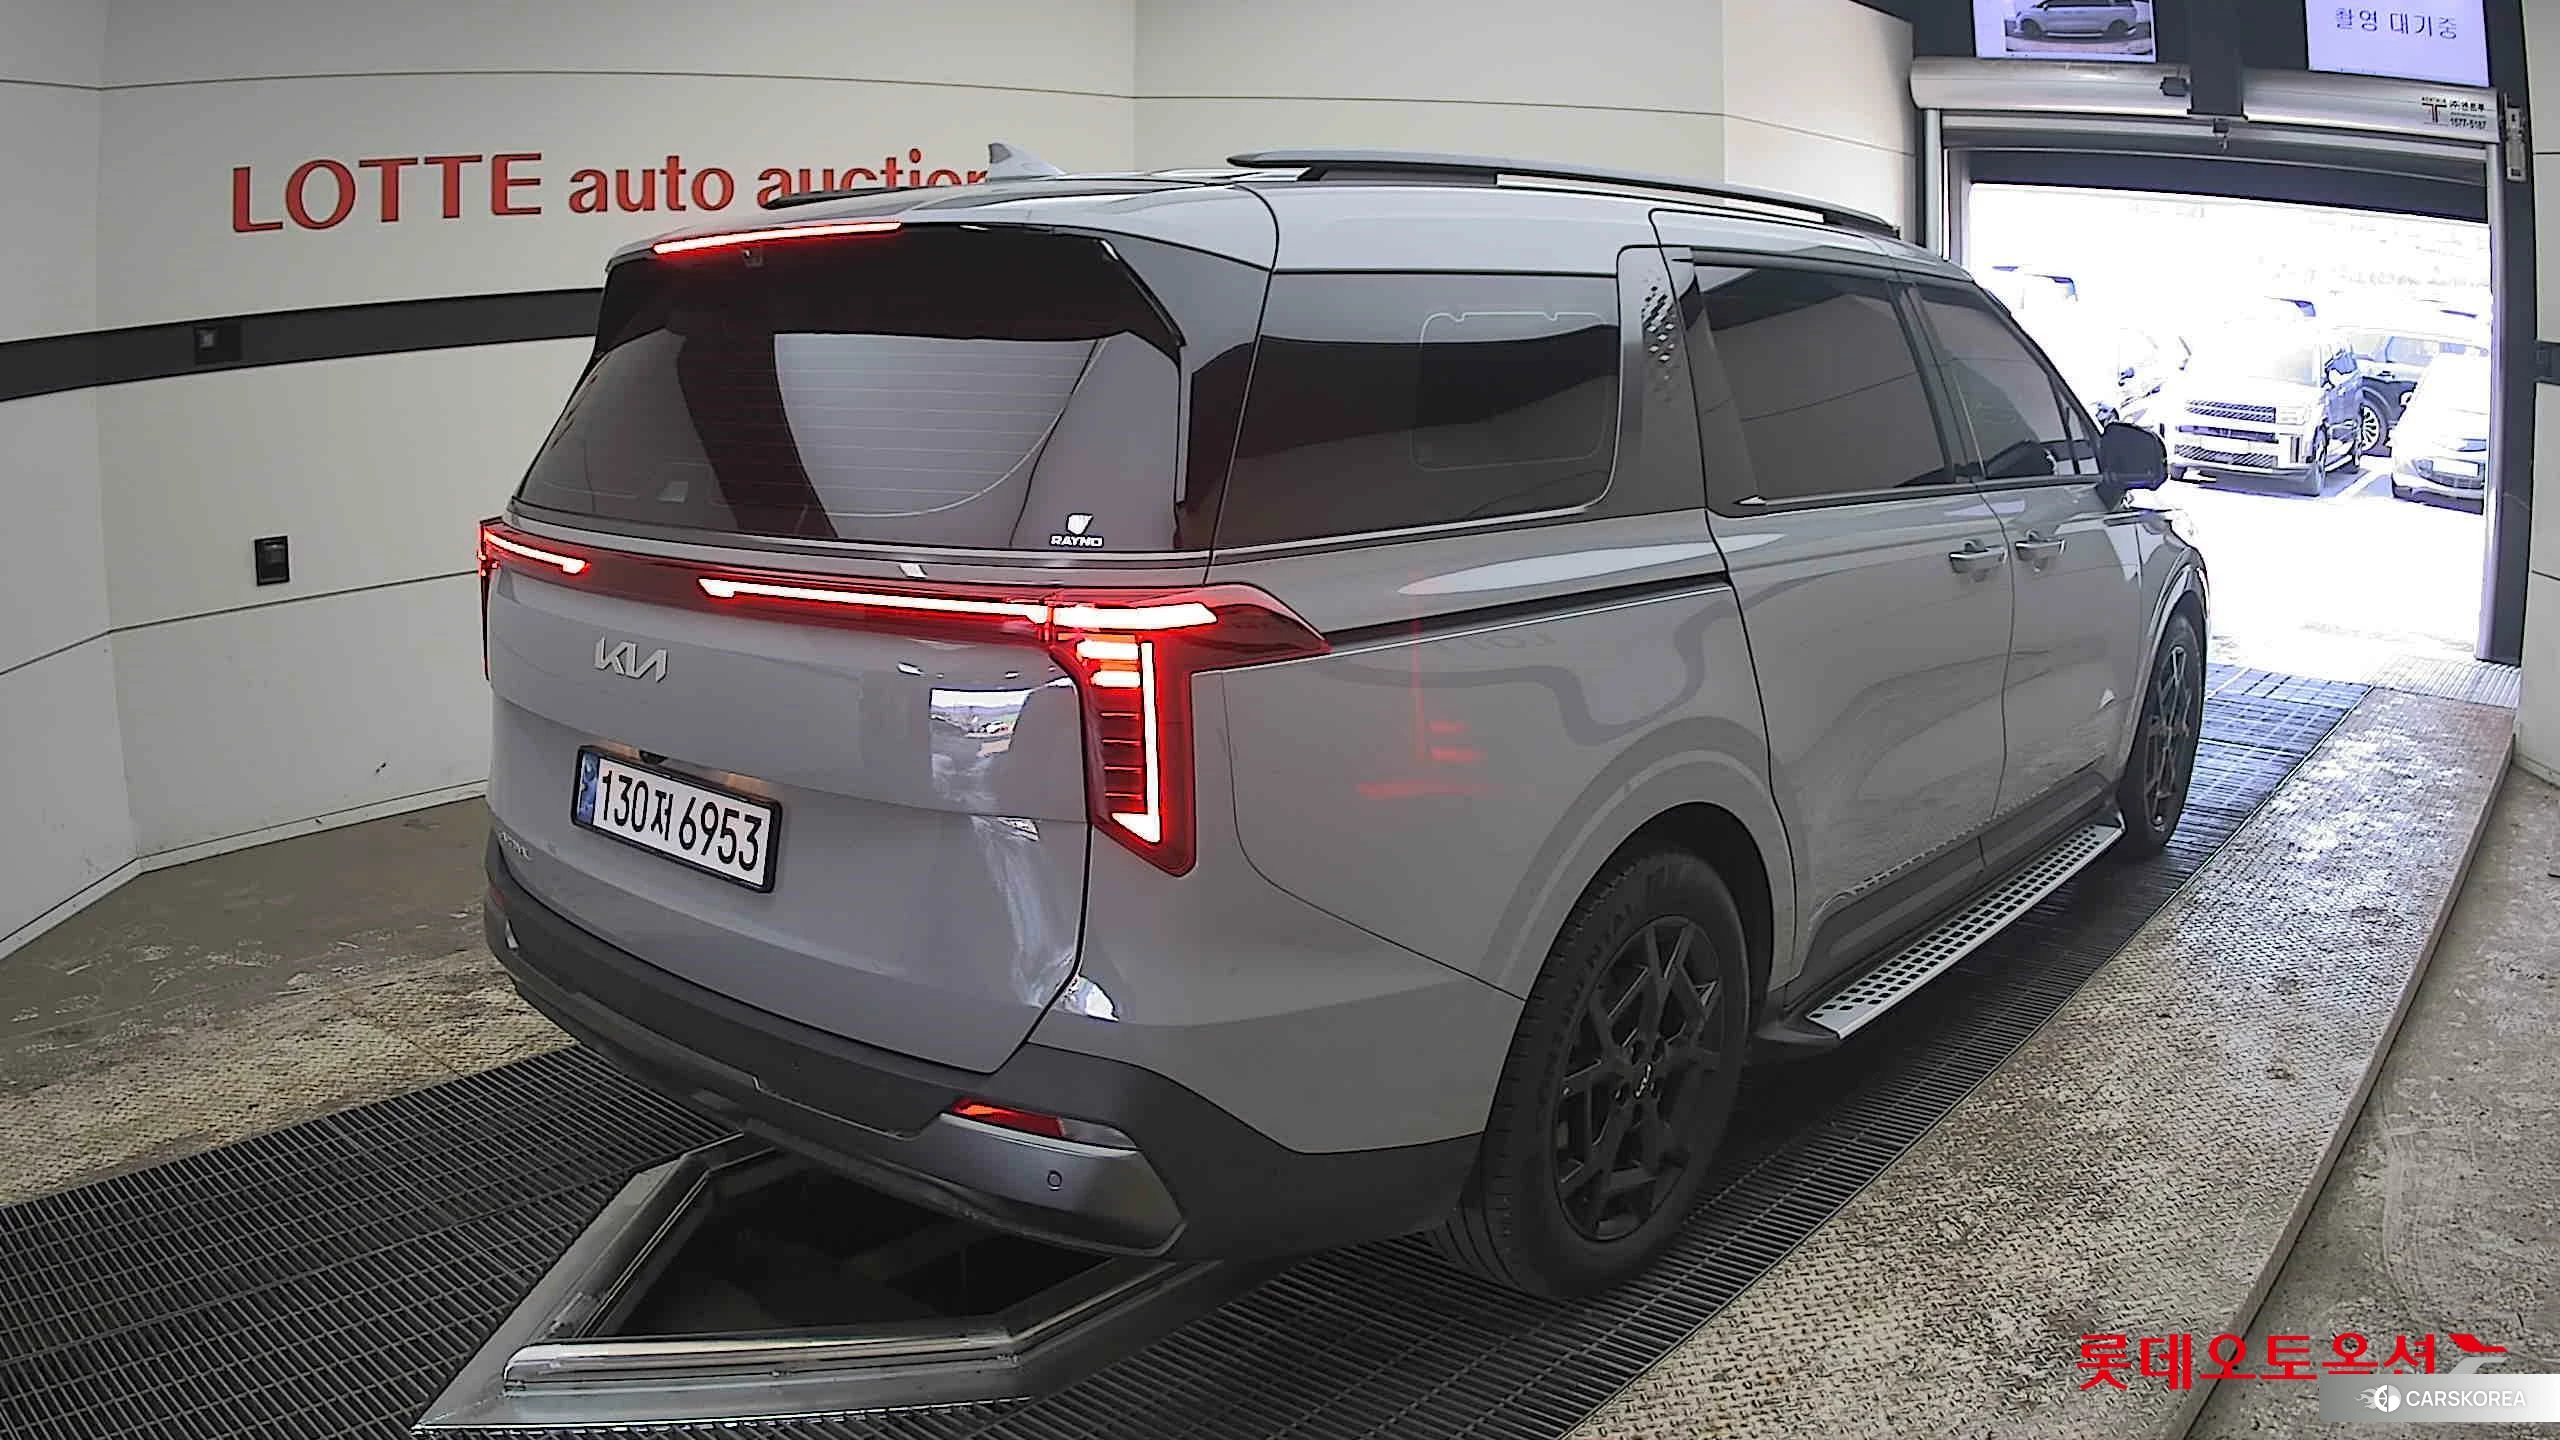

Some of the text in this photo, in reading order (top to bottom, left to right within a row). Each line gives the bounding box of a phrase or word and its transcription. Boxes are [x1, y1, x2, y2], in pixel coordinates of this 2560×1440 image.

[2390, 13, 2457, 40] 대기중
[233, 152, 542, 232] LOTTE
[569, 154, 735, 213] auto
[1050, 534, 1104, 548] RAYNO
[593, 633, 669, 683] KIA
